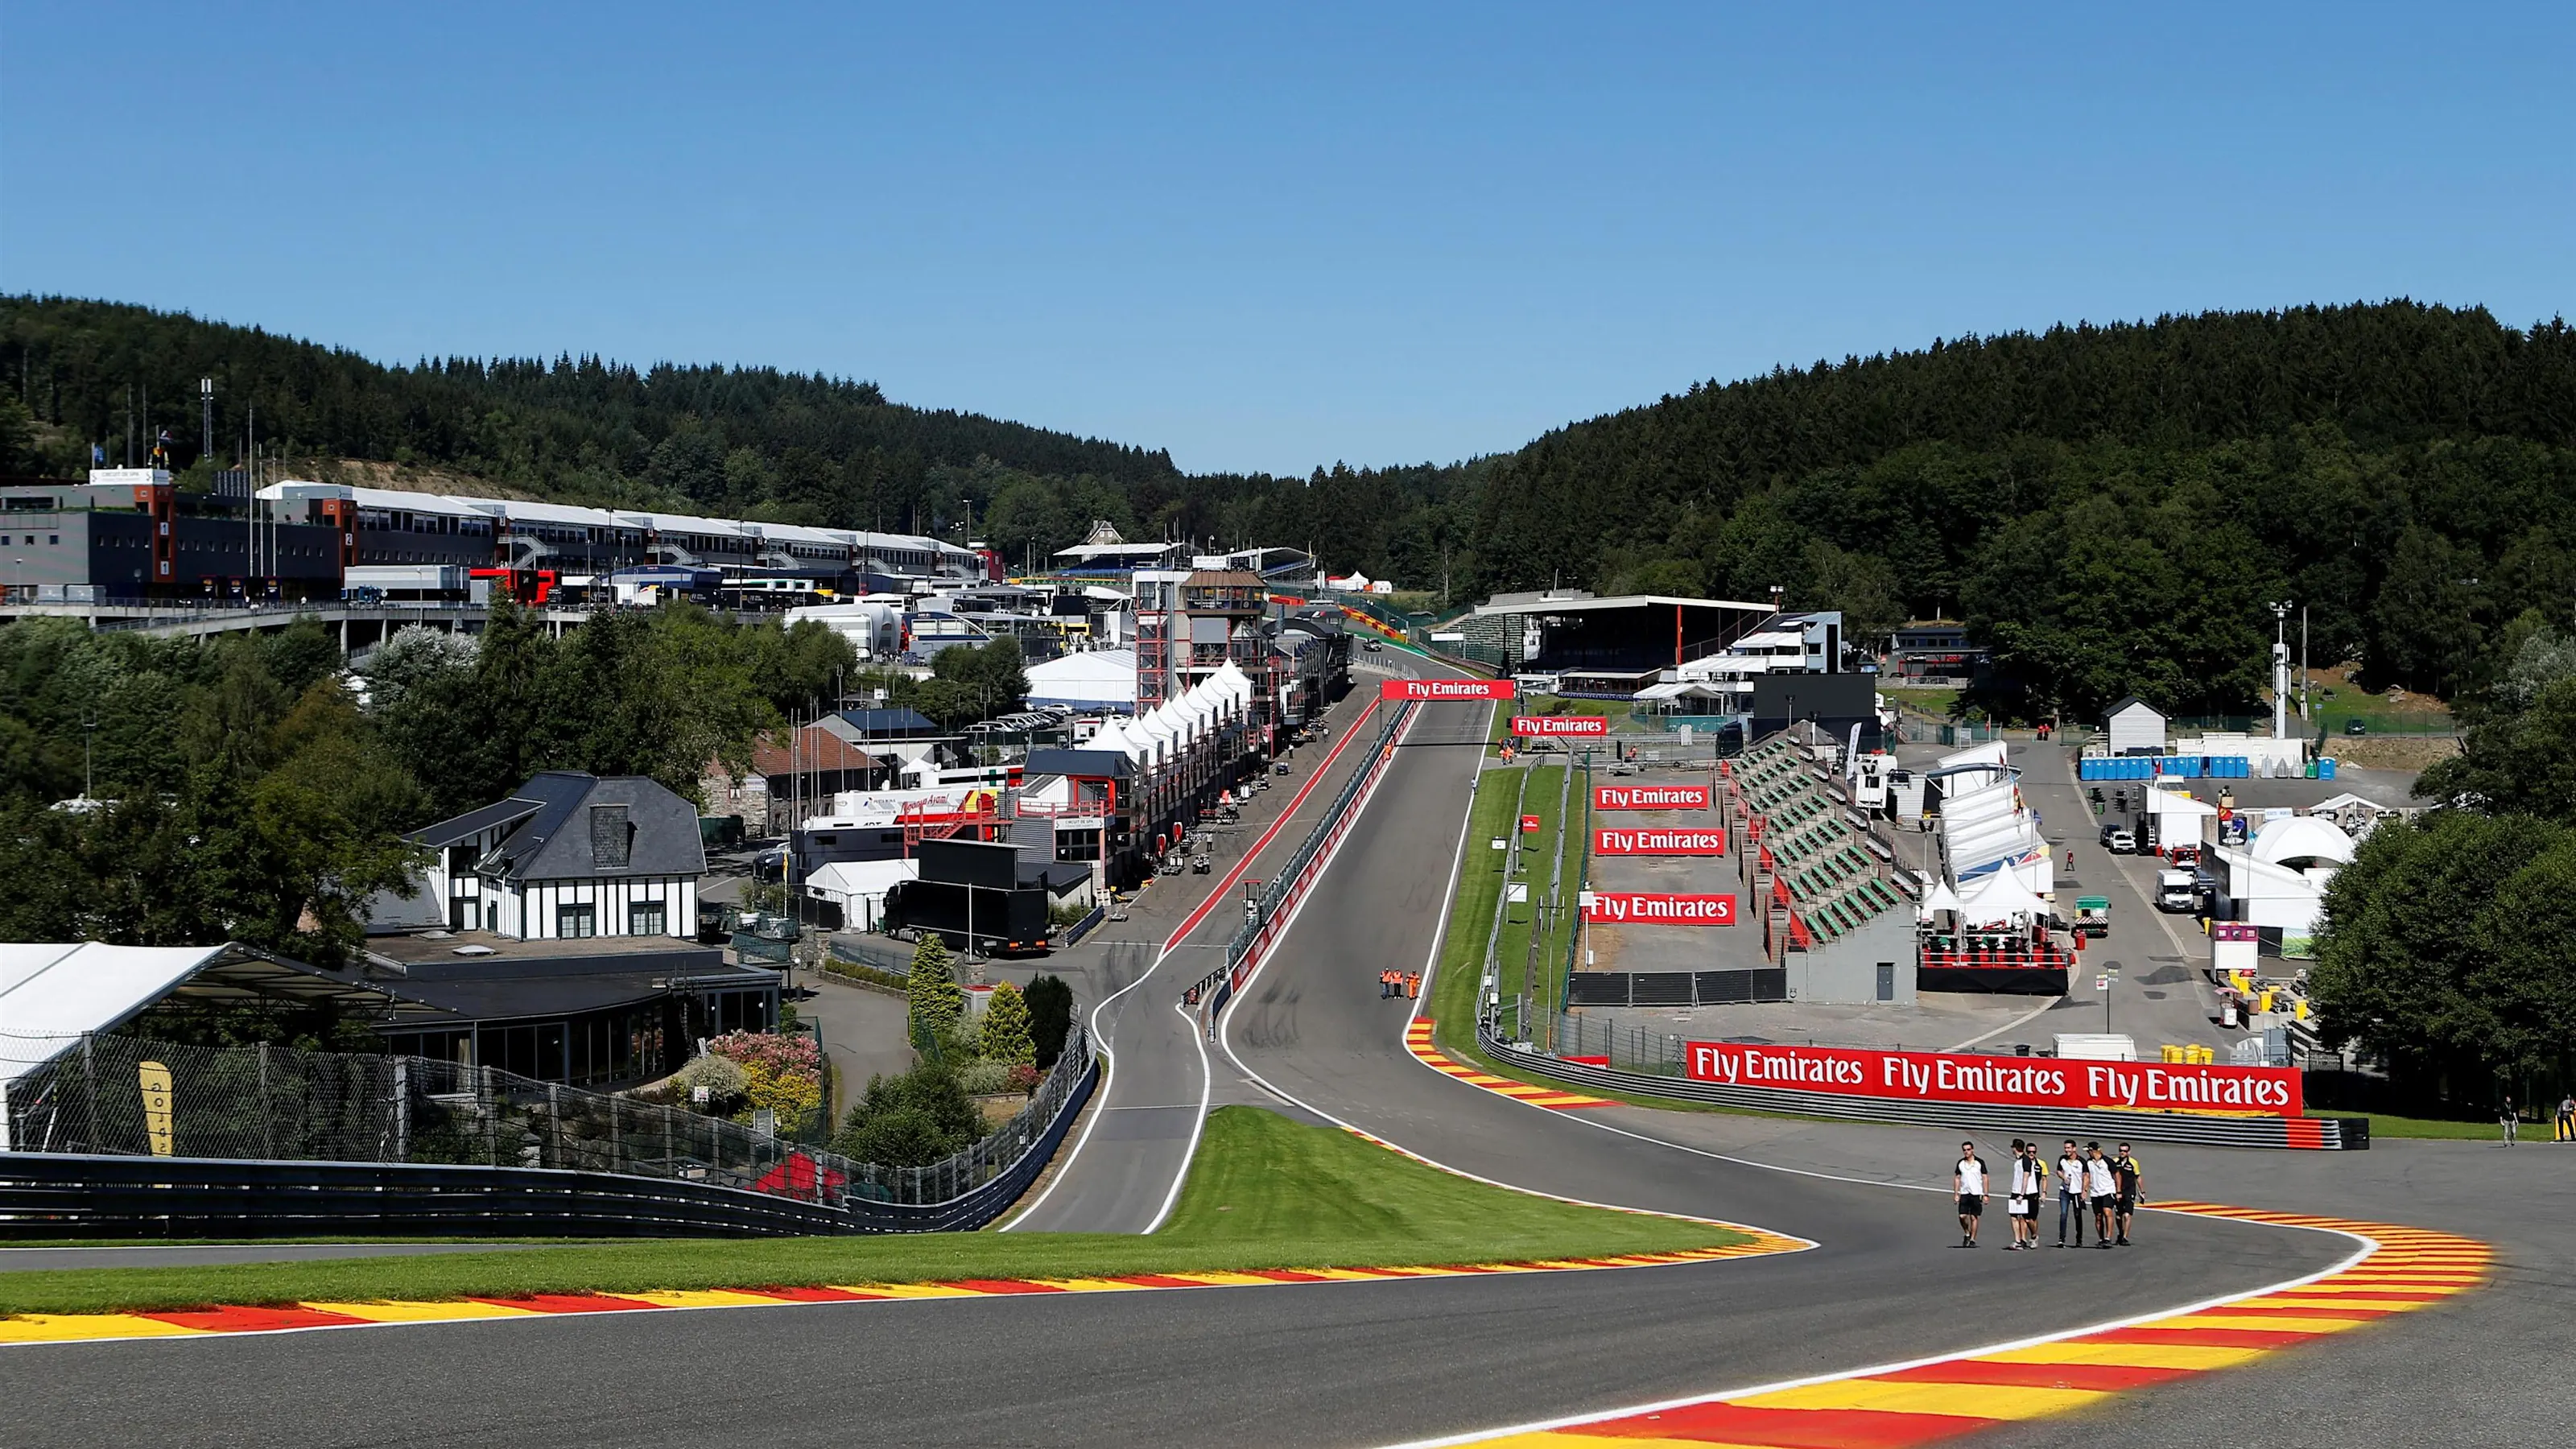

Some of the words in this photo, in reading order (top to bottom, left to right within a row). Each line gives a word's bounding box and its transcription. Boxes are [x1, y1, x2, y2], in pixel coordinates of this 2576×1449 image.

[1407, 682, 1430, 697] Fly
[1432, 682, 1489, 695] Emirates
[1517, 719, 1540, 734] Fly
[1542, 719, 1602, 732] Emirates
[1601, 789, 1629, 807] Fly
[1632, 788, 1703, 803] Emirates
[1602, 832, 1633, 852] Fly
[1637, 831, 1719, 848] Emirates
[1591, 896, 1627, 920] Fly
[1631, 897, 1728, 918] Emirates
[1695, 1047, 1739, 1084] Fly
[1744, 1051, 1864, 1084] Emirates
[1882, 1057, 1930, 1095] Fly
[1935, 1059, 2066, 1095] Emirates
[2087, 1066, 2139, 1106] Fly
[2145, 1069, 2289, 1106] Emirates
